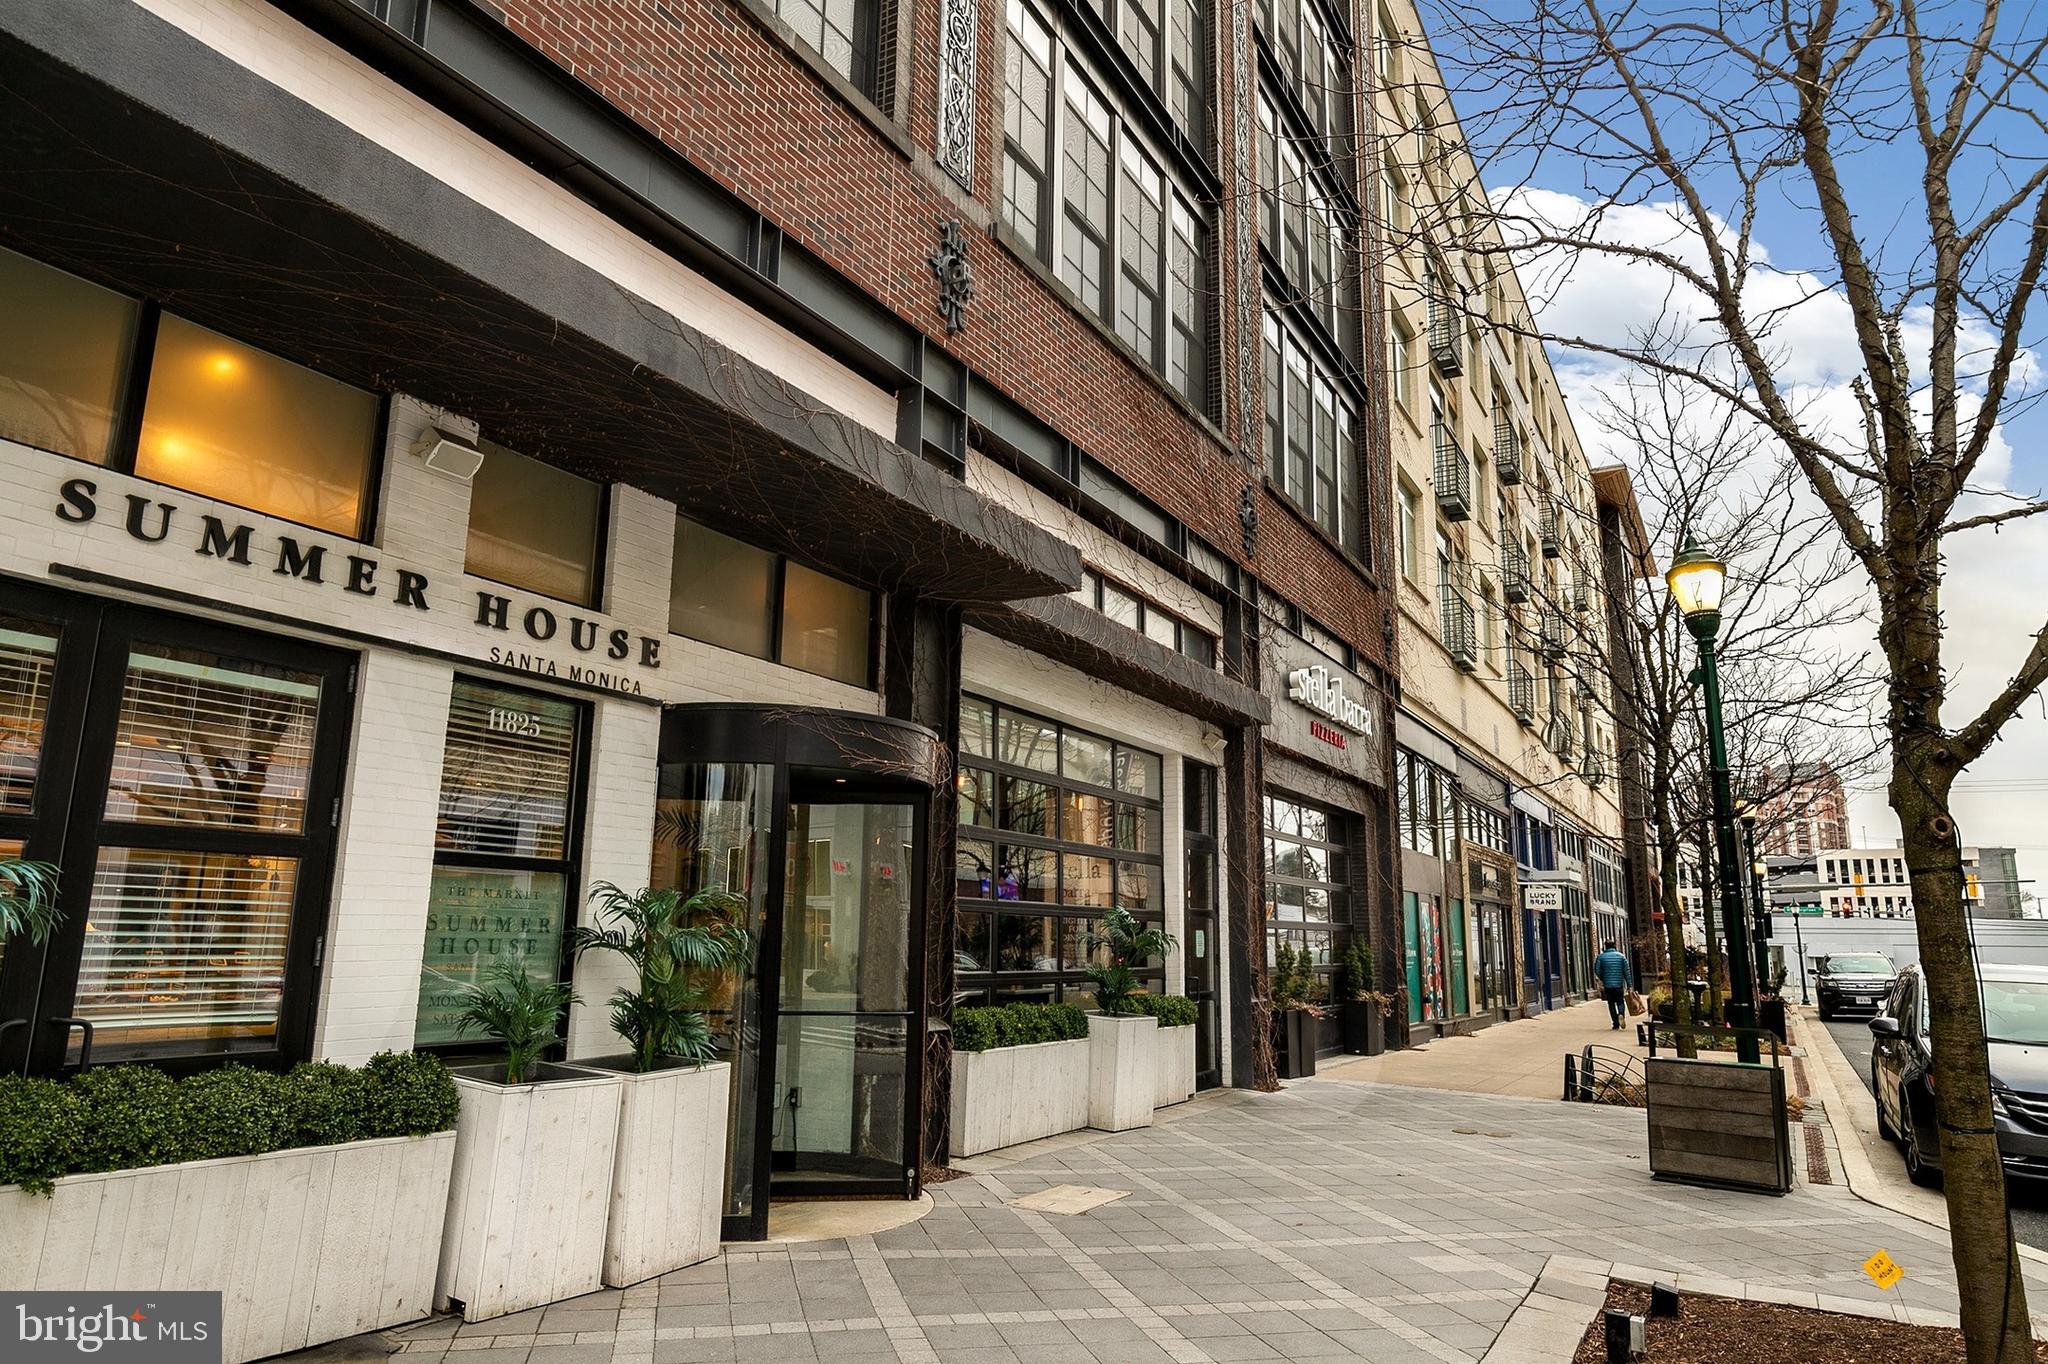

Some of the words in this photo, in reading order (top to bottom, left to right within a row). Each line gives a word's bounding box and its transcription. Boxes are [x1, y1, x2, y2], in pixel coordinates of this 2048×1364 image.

[56, 478, 430, 611] SUMMER
[474, 591, 661, 668] HOUSE
[490, 647, 556, 676] SANTA
[569, 665, 642, 695] MONICA
[487, 708, 541, 737] 11825
[1310, 720, 1347, 750] PIZZERIA
[447, 886, 476, 897] THE
[482, 888, 540, 900] MARKET
[426, 913, 551, 934] SUMMER
[438, 937, 538, 955] HOUSE
